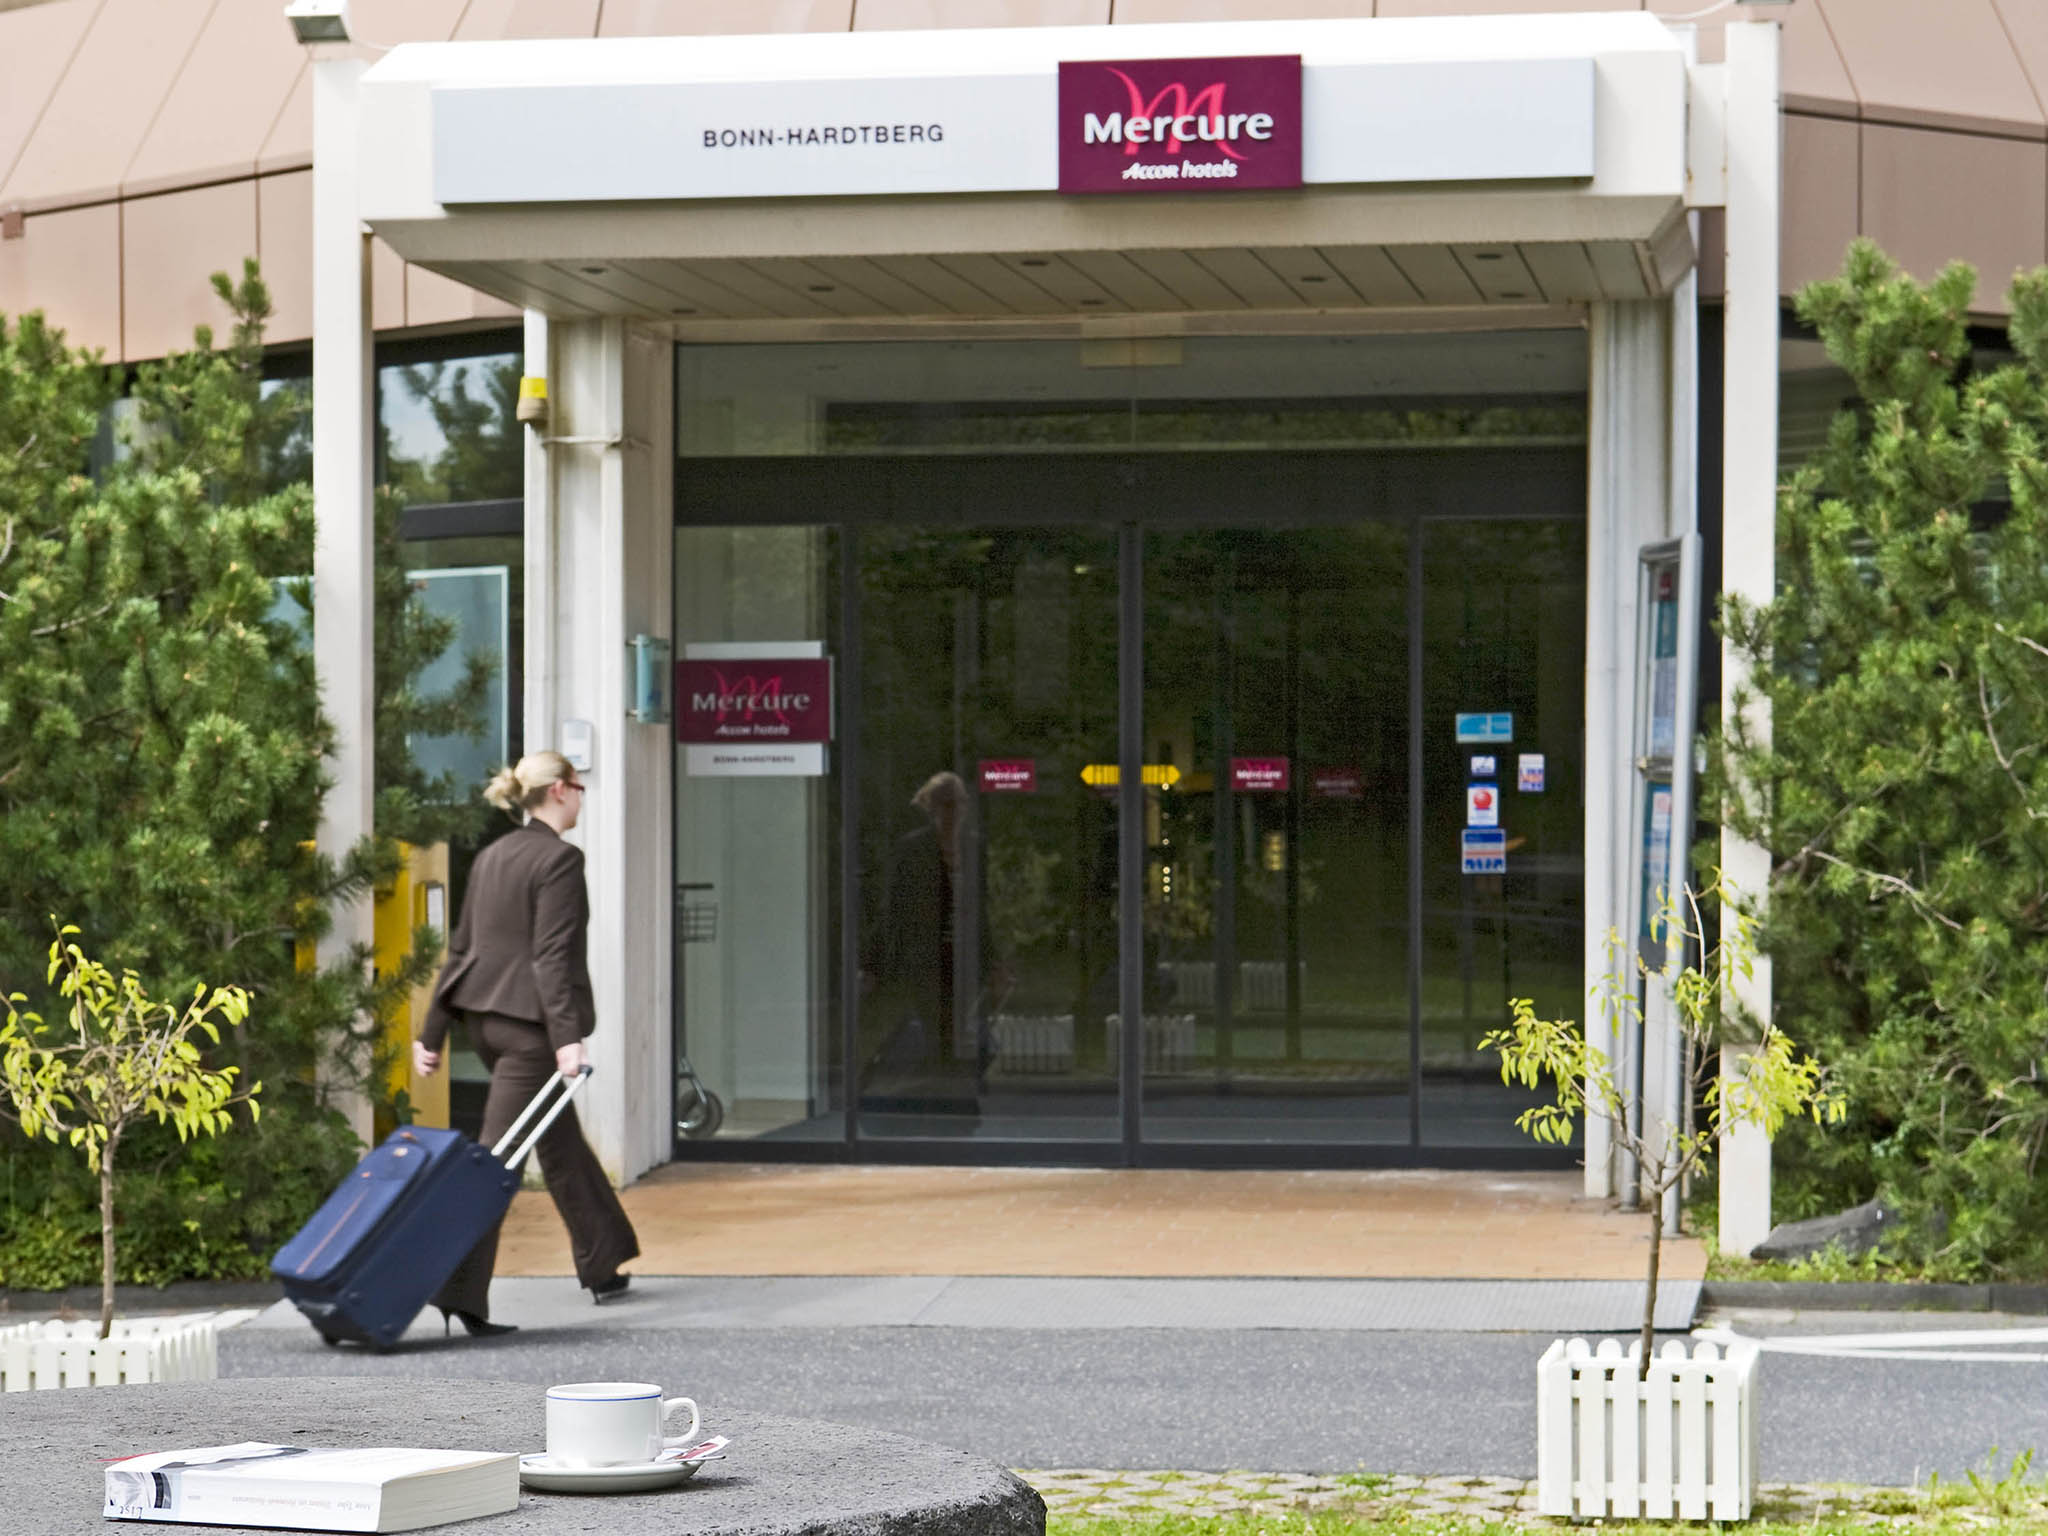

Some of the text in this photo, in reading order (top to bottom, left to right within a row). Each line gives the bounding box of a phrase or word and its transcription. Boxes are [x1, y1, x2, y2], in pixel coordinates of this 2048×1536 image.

[703, 124, 944, 148] BONN-HARDTBERG
[1083, 112, 1274, 144] Mercure
[1181, 159, 1237, 179] hotels
[692, 692, 810, 712] Mercure
